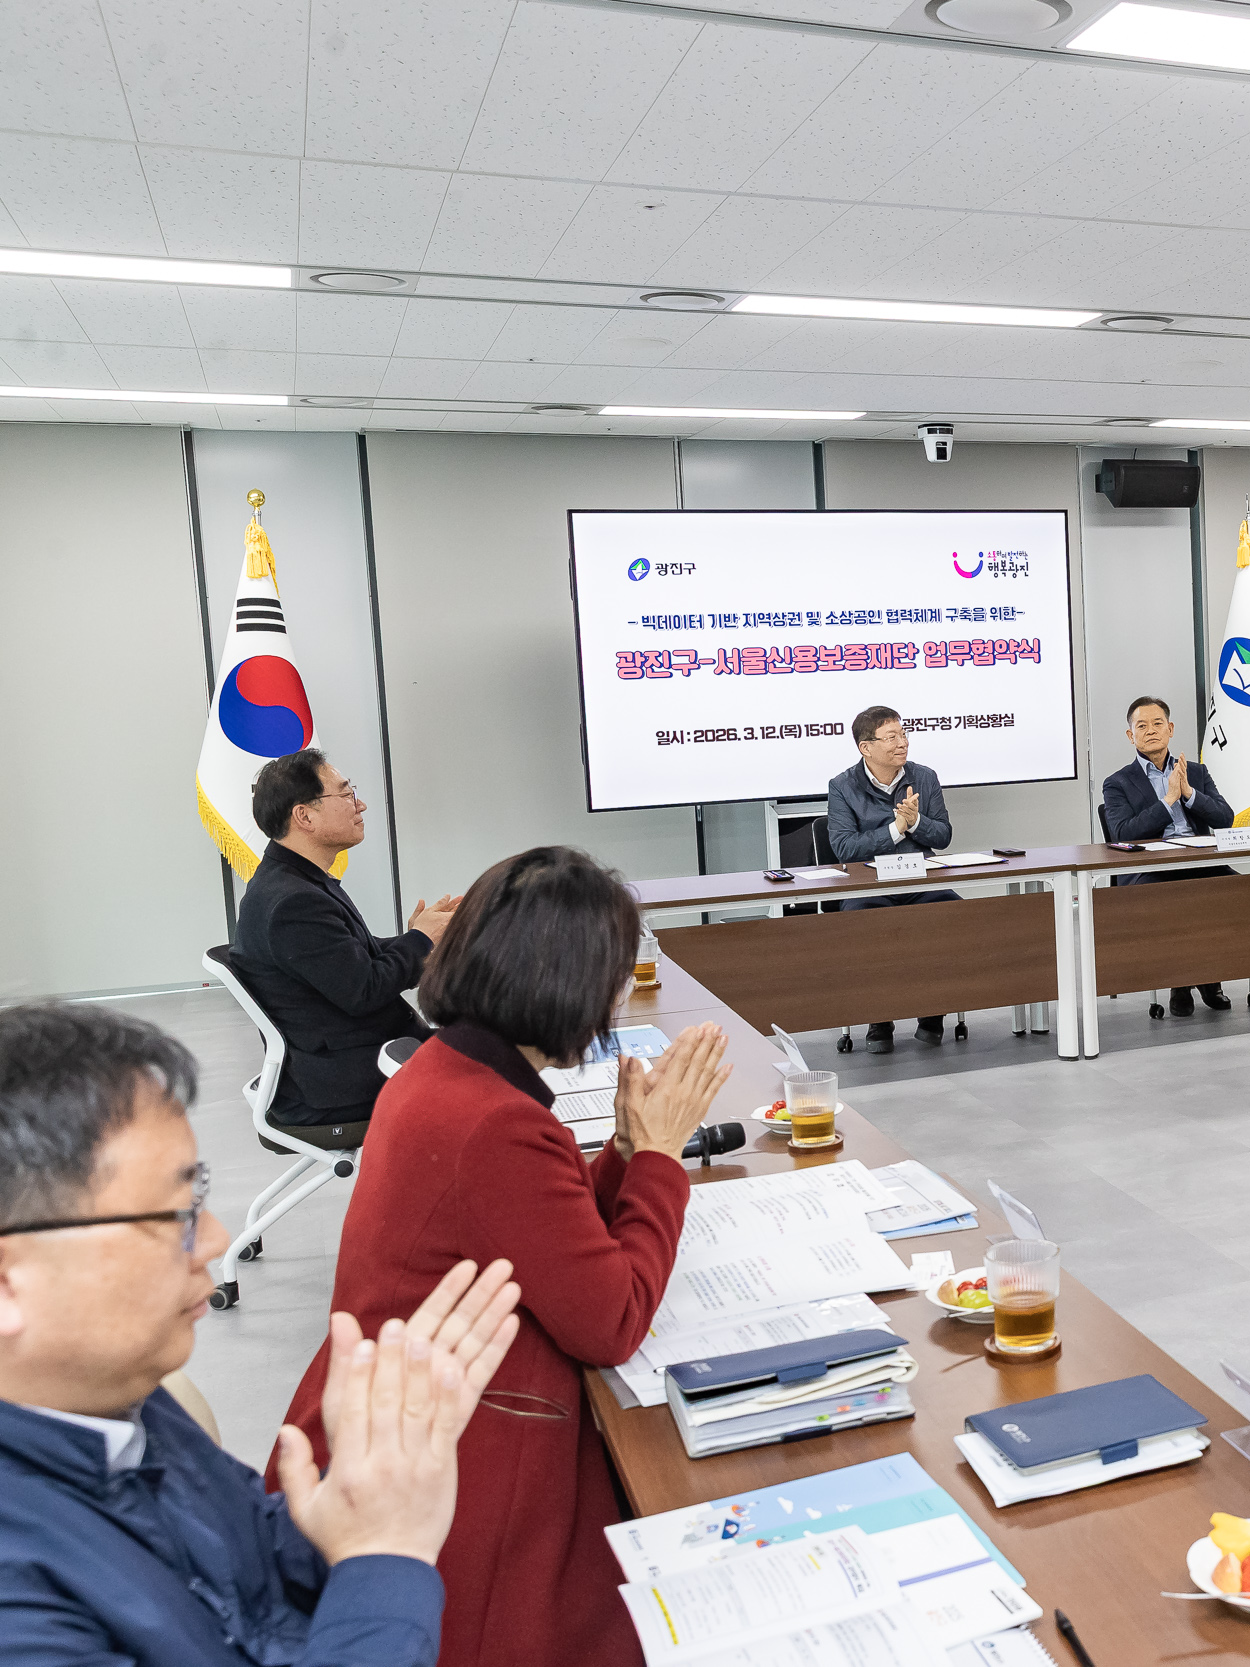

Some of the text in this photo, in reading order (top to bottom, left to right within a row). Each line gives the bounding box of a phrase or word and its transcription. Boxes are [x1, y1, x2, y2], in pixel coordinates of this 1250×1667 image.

[654, 562, 697, 577] 광진구
[987, 559, 1029, 579] 행복광진
[641, 614, 705, 631] 빅데이터
[707, 613, 739, 629] 기반
[742, 612, 803, 628] 지역상권
[805, 611, 822, 627] 및
[825, 609, 883, 626] 소상공인
[885, 608, 943, 625] 협력체계
[945, 606, 986, 623] 구축을
[615, 637, 1042, 680] 광진구-서울신용보증재단 업무협약식
[655, 730, 684, 746] 일시
[693, 728, 742, 743] 2026.
[743, 727, 758, 740] 3.
[759, 723, 802, 740] 12.(목)
[803, 722, 845, 737] 15:00
[902, 713, 1015, 733] 광진구청 기획상황실
